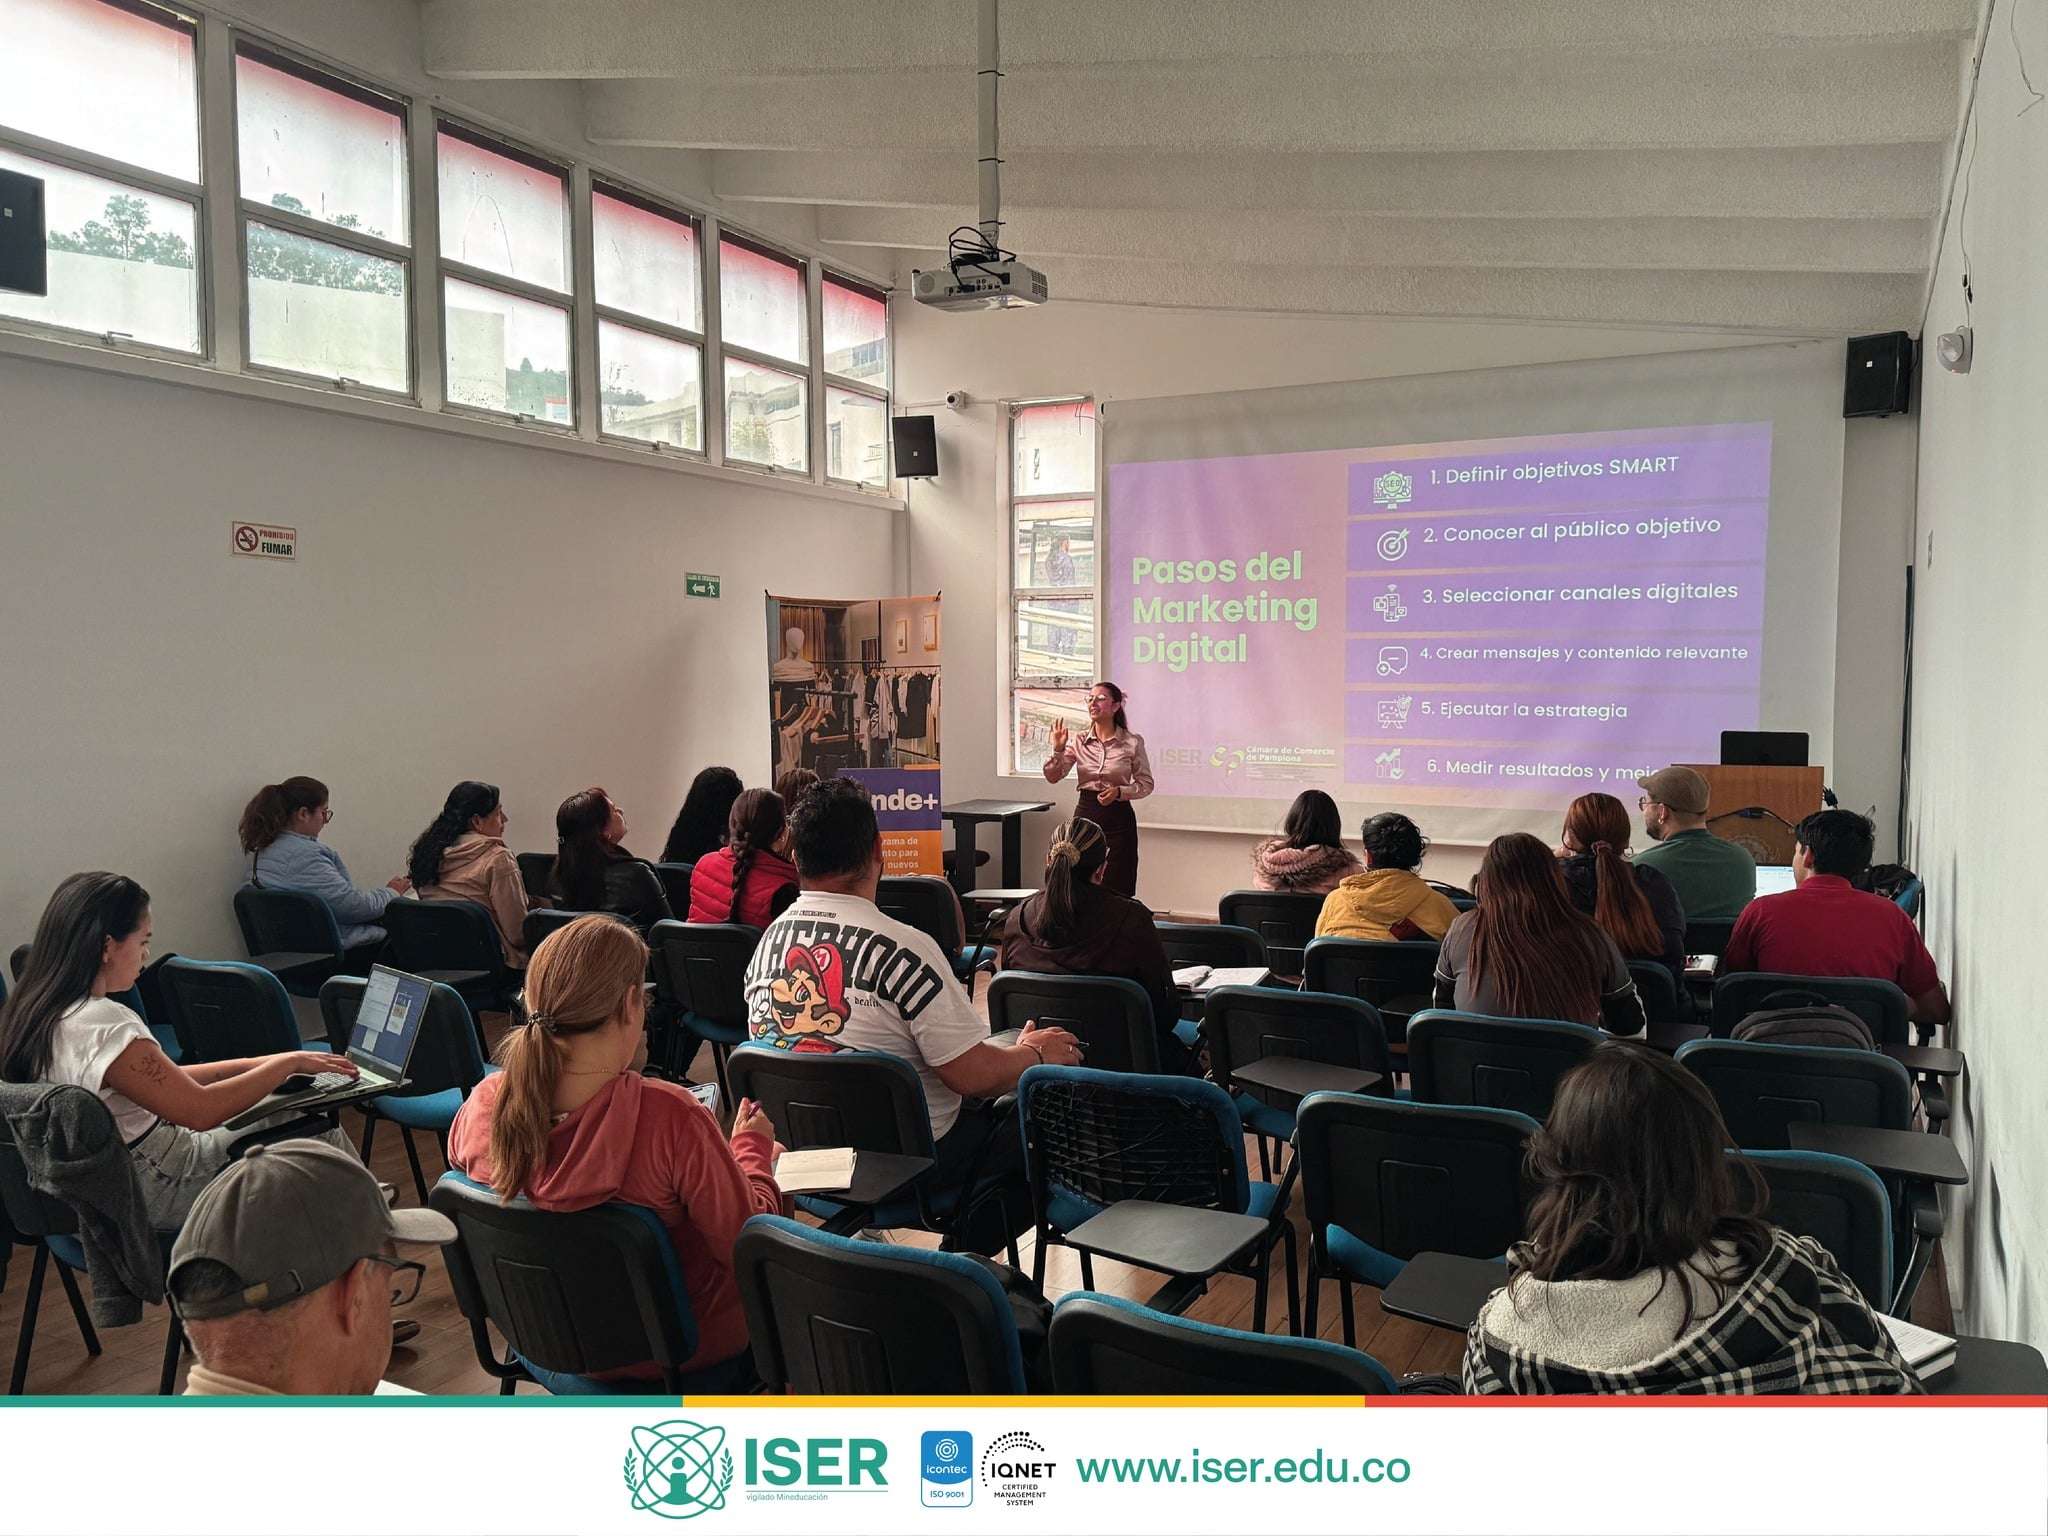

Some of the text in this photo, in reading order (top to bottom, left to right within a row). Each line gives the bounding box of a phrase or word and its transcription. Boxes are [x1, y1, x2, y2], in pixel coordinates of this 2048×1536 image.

[1430, 456, 1680, 485] 1. Definir objetivos SMART
[1423, 516, 1721, 543] 2. Conocer al público objetivo
[261, 541, 293, 555] FUMAR
[1132, 550, 1302, 585] Pasos del
[1422, 582, 1739, 604] 3. Seleccionar canales digitales
[1132, 589, 1318, 632] Marketing
[1133, 631, 1248, 673] Digital
[1419, 645, 1749, 662] 4. Crear mensajes y contenido relevante
[1421, 701, 1629, 722] 5. Ejecutar la estrategia
[1427, 759, 1441, 773] 6.
[1446, 760, 1494, 775] Medir
[1499, 762, 1594, 777] resultados
[1598, 767, 1610, 781] y
[882, 838, 905, 846] rama
